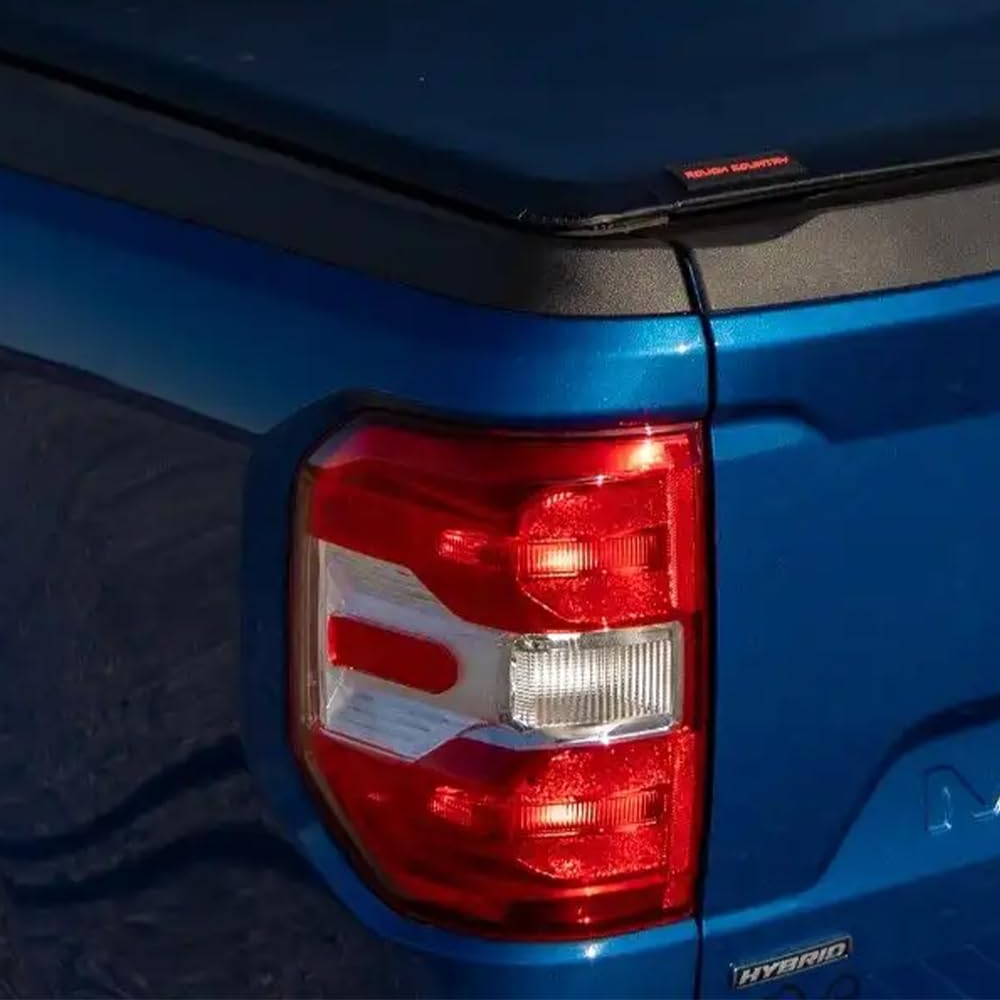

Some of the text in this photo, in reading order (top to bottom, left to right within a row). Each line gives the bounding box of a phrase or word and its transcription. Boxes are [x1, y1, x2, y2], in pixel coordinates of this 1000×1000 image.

[684, 155, 789, 180] ROUGH COUNTRY
[739, 942, 848, 985] HYBRID
